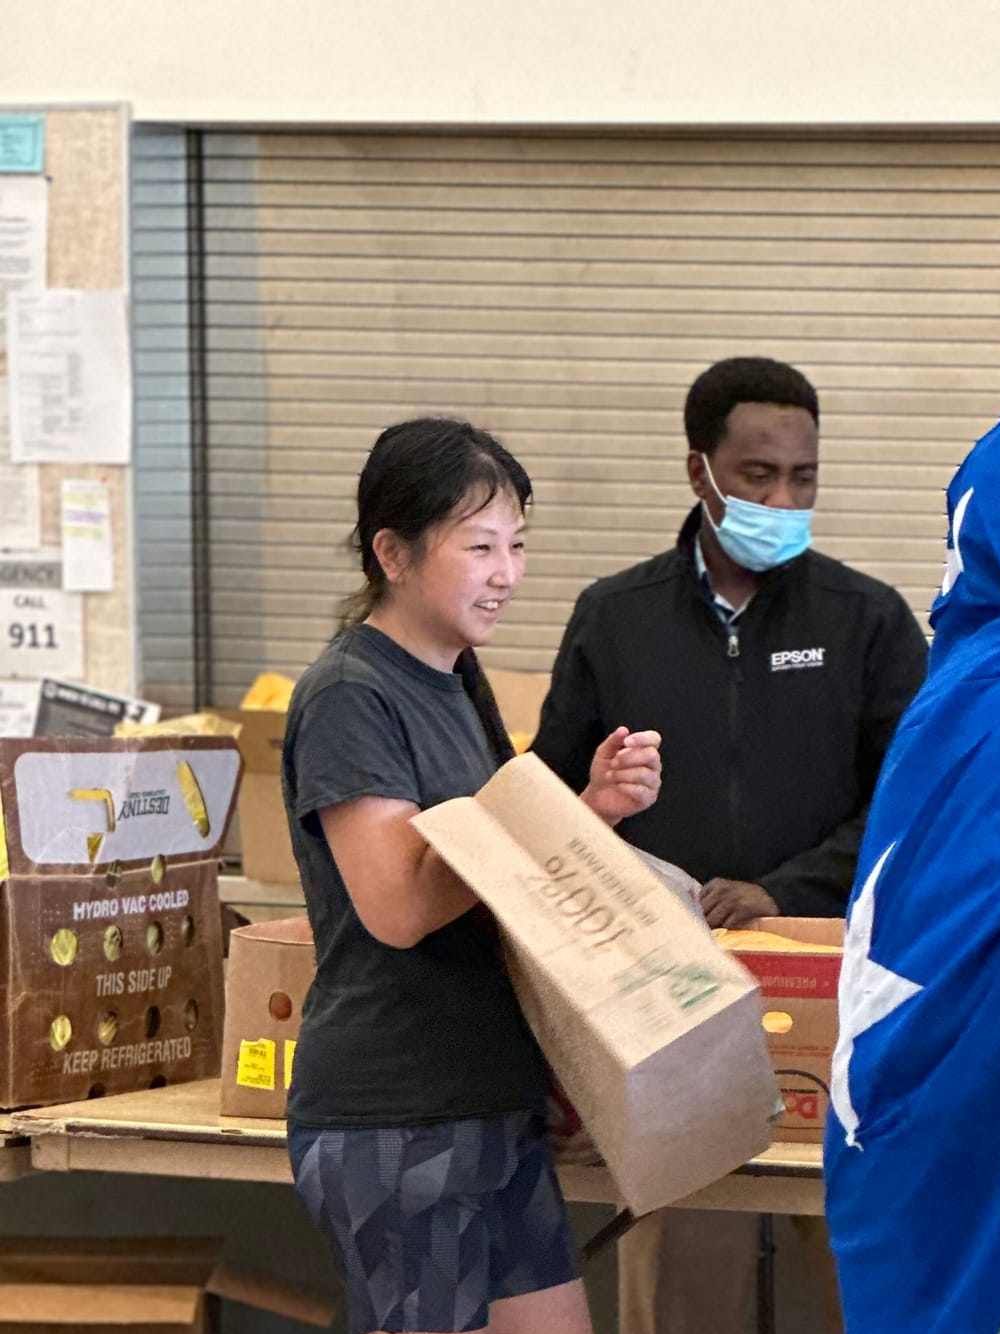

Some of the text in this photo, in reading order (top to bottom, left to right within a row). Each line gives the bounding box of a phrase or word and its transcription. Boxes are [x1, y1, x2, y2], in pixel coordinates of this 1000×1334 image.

[0, 565, 56, 583] GENCY
[13, 594, 46, 609] CALL
[9, 623, 58, 649] 911
[771, 647, 825, 666] EPSON
[117, 795, 170, 821] DESTINY
[73, 889, 190, 921] HYDRO VAC COOLED
[96, 966, 173, 997] THIS SIDE UP
[63, 1036, 192, 1075] KEEP REFRIGERATED
